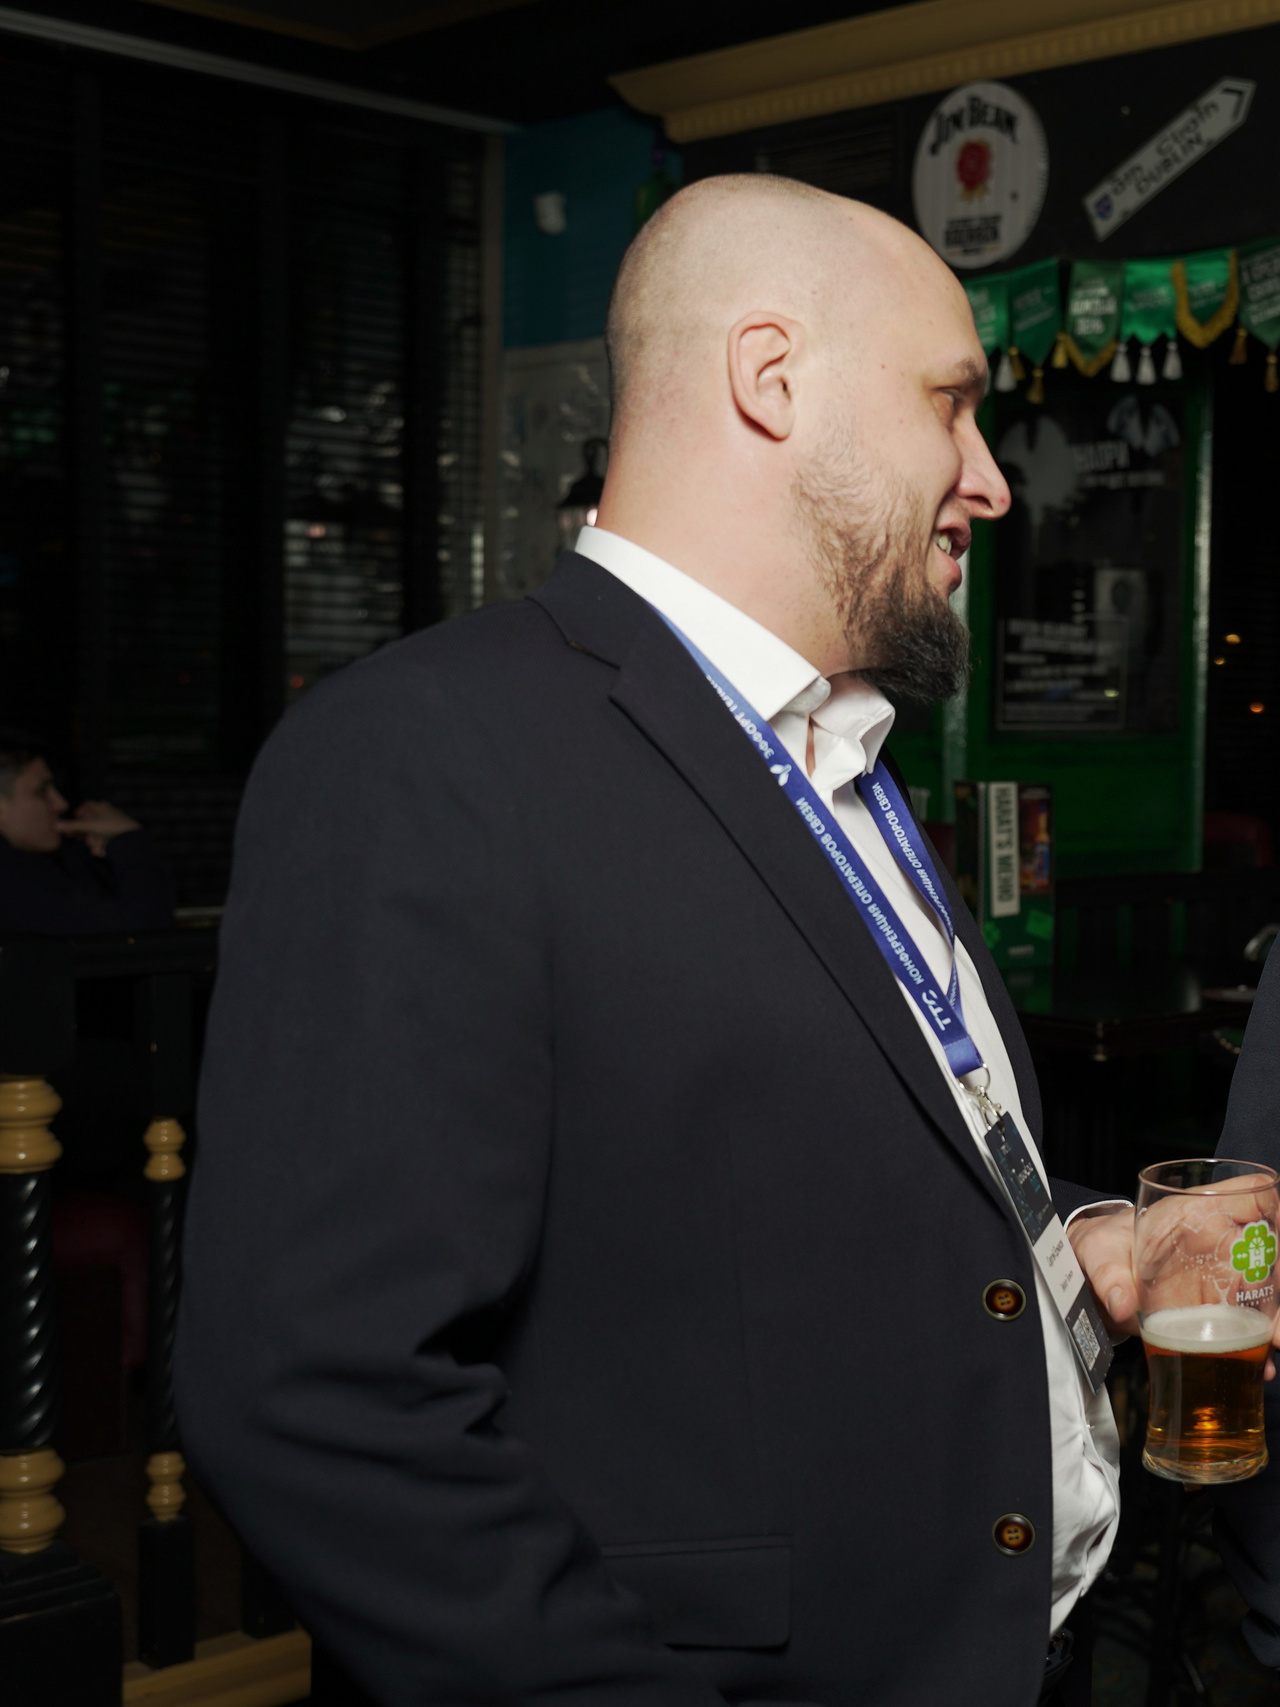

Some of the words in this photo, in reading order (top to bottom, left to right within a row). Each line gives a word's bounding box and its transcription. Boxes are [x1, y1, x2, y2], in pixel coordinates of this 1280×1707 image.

[796, 797, 825, 835] СВЯЗИ
[872, 782, 891, 811] СВЯЗИ
[885, 811, 922, 868] ОПЕРАТОРОВ
[821, 834, 872, 904] ОПЕРАТОРОВ
[867, 903, 924, 985] КОНФЕРЕНЦИЯ
